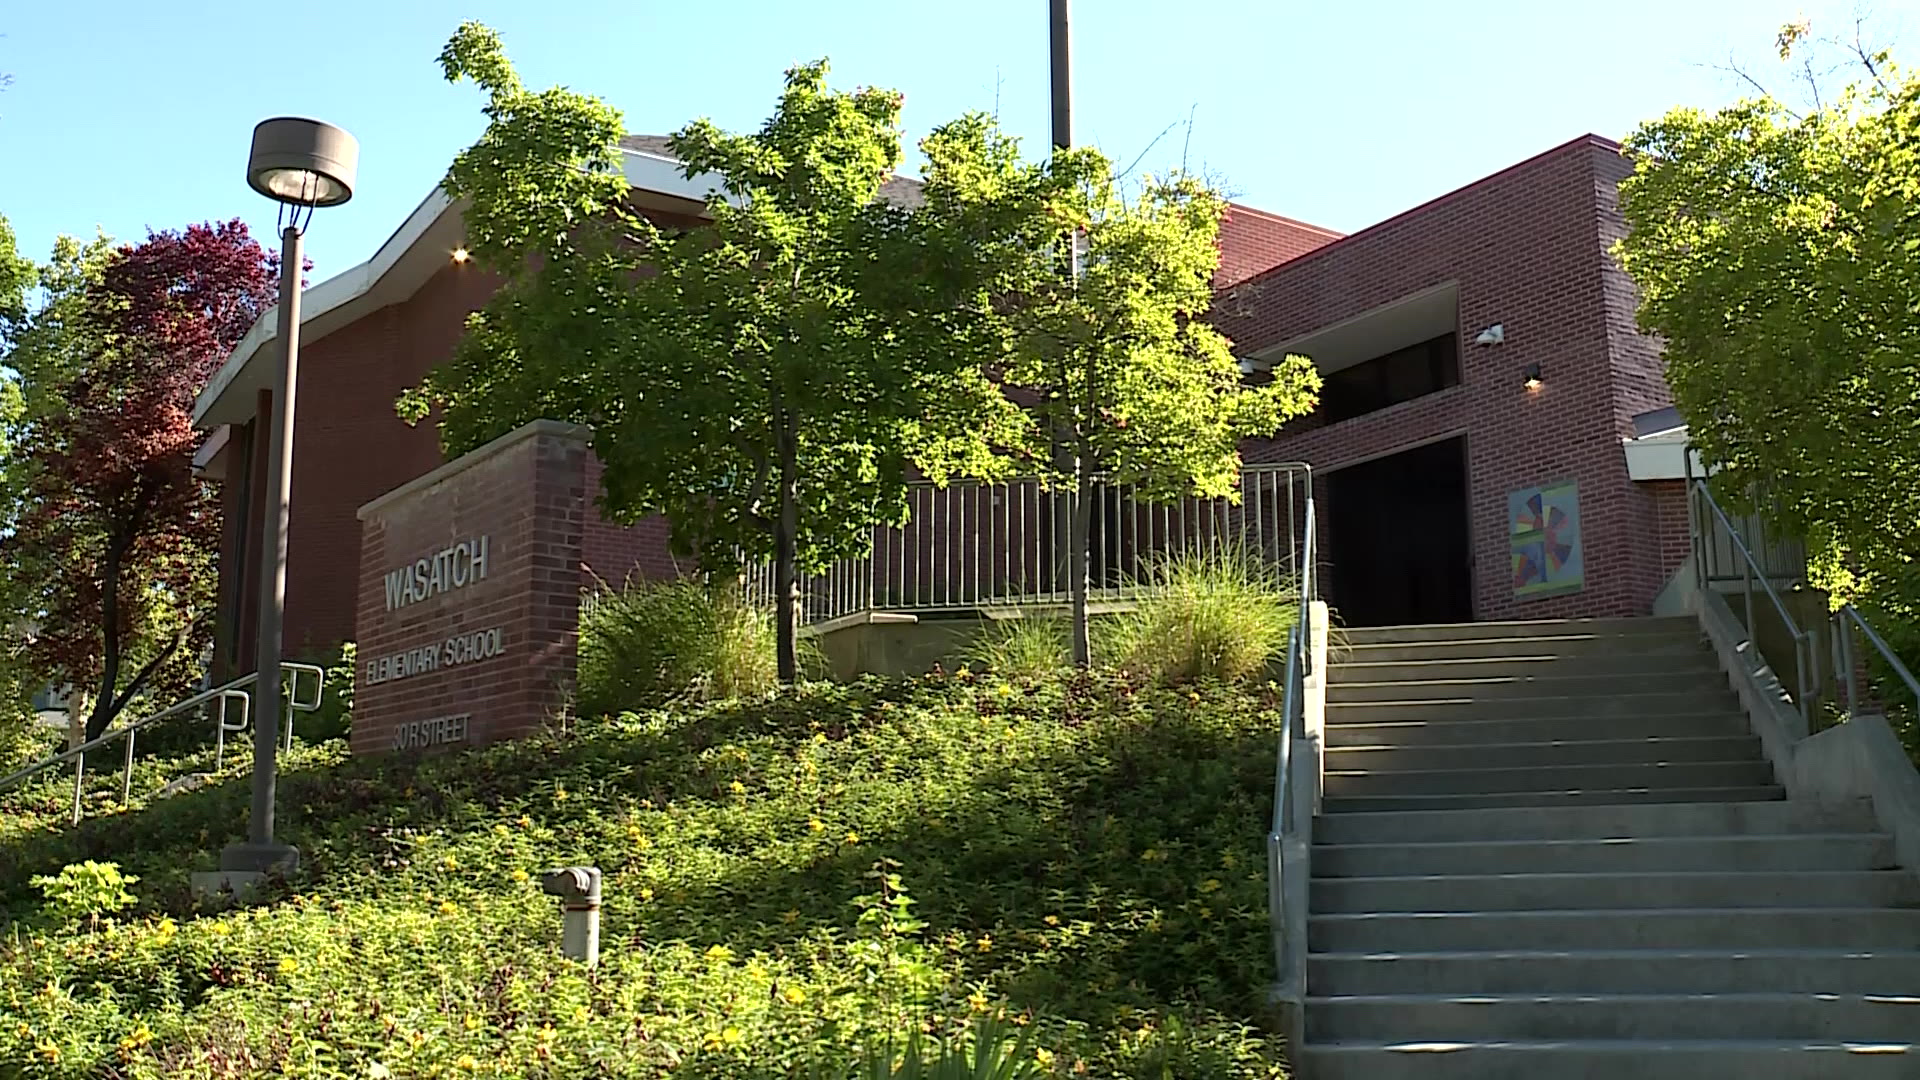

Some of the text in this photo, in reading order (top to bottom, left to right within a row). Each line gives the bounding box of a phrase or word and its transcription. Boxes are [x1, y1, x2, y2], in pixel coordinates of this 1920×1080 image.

[384, 535, 489, 612] WASATCH
[365, 627, 505, 686] ELEMENTARY SCHOOL
